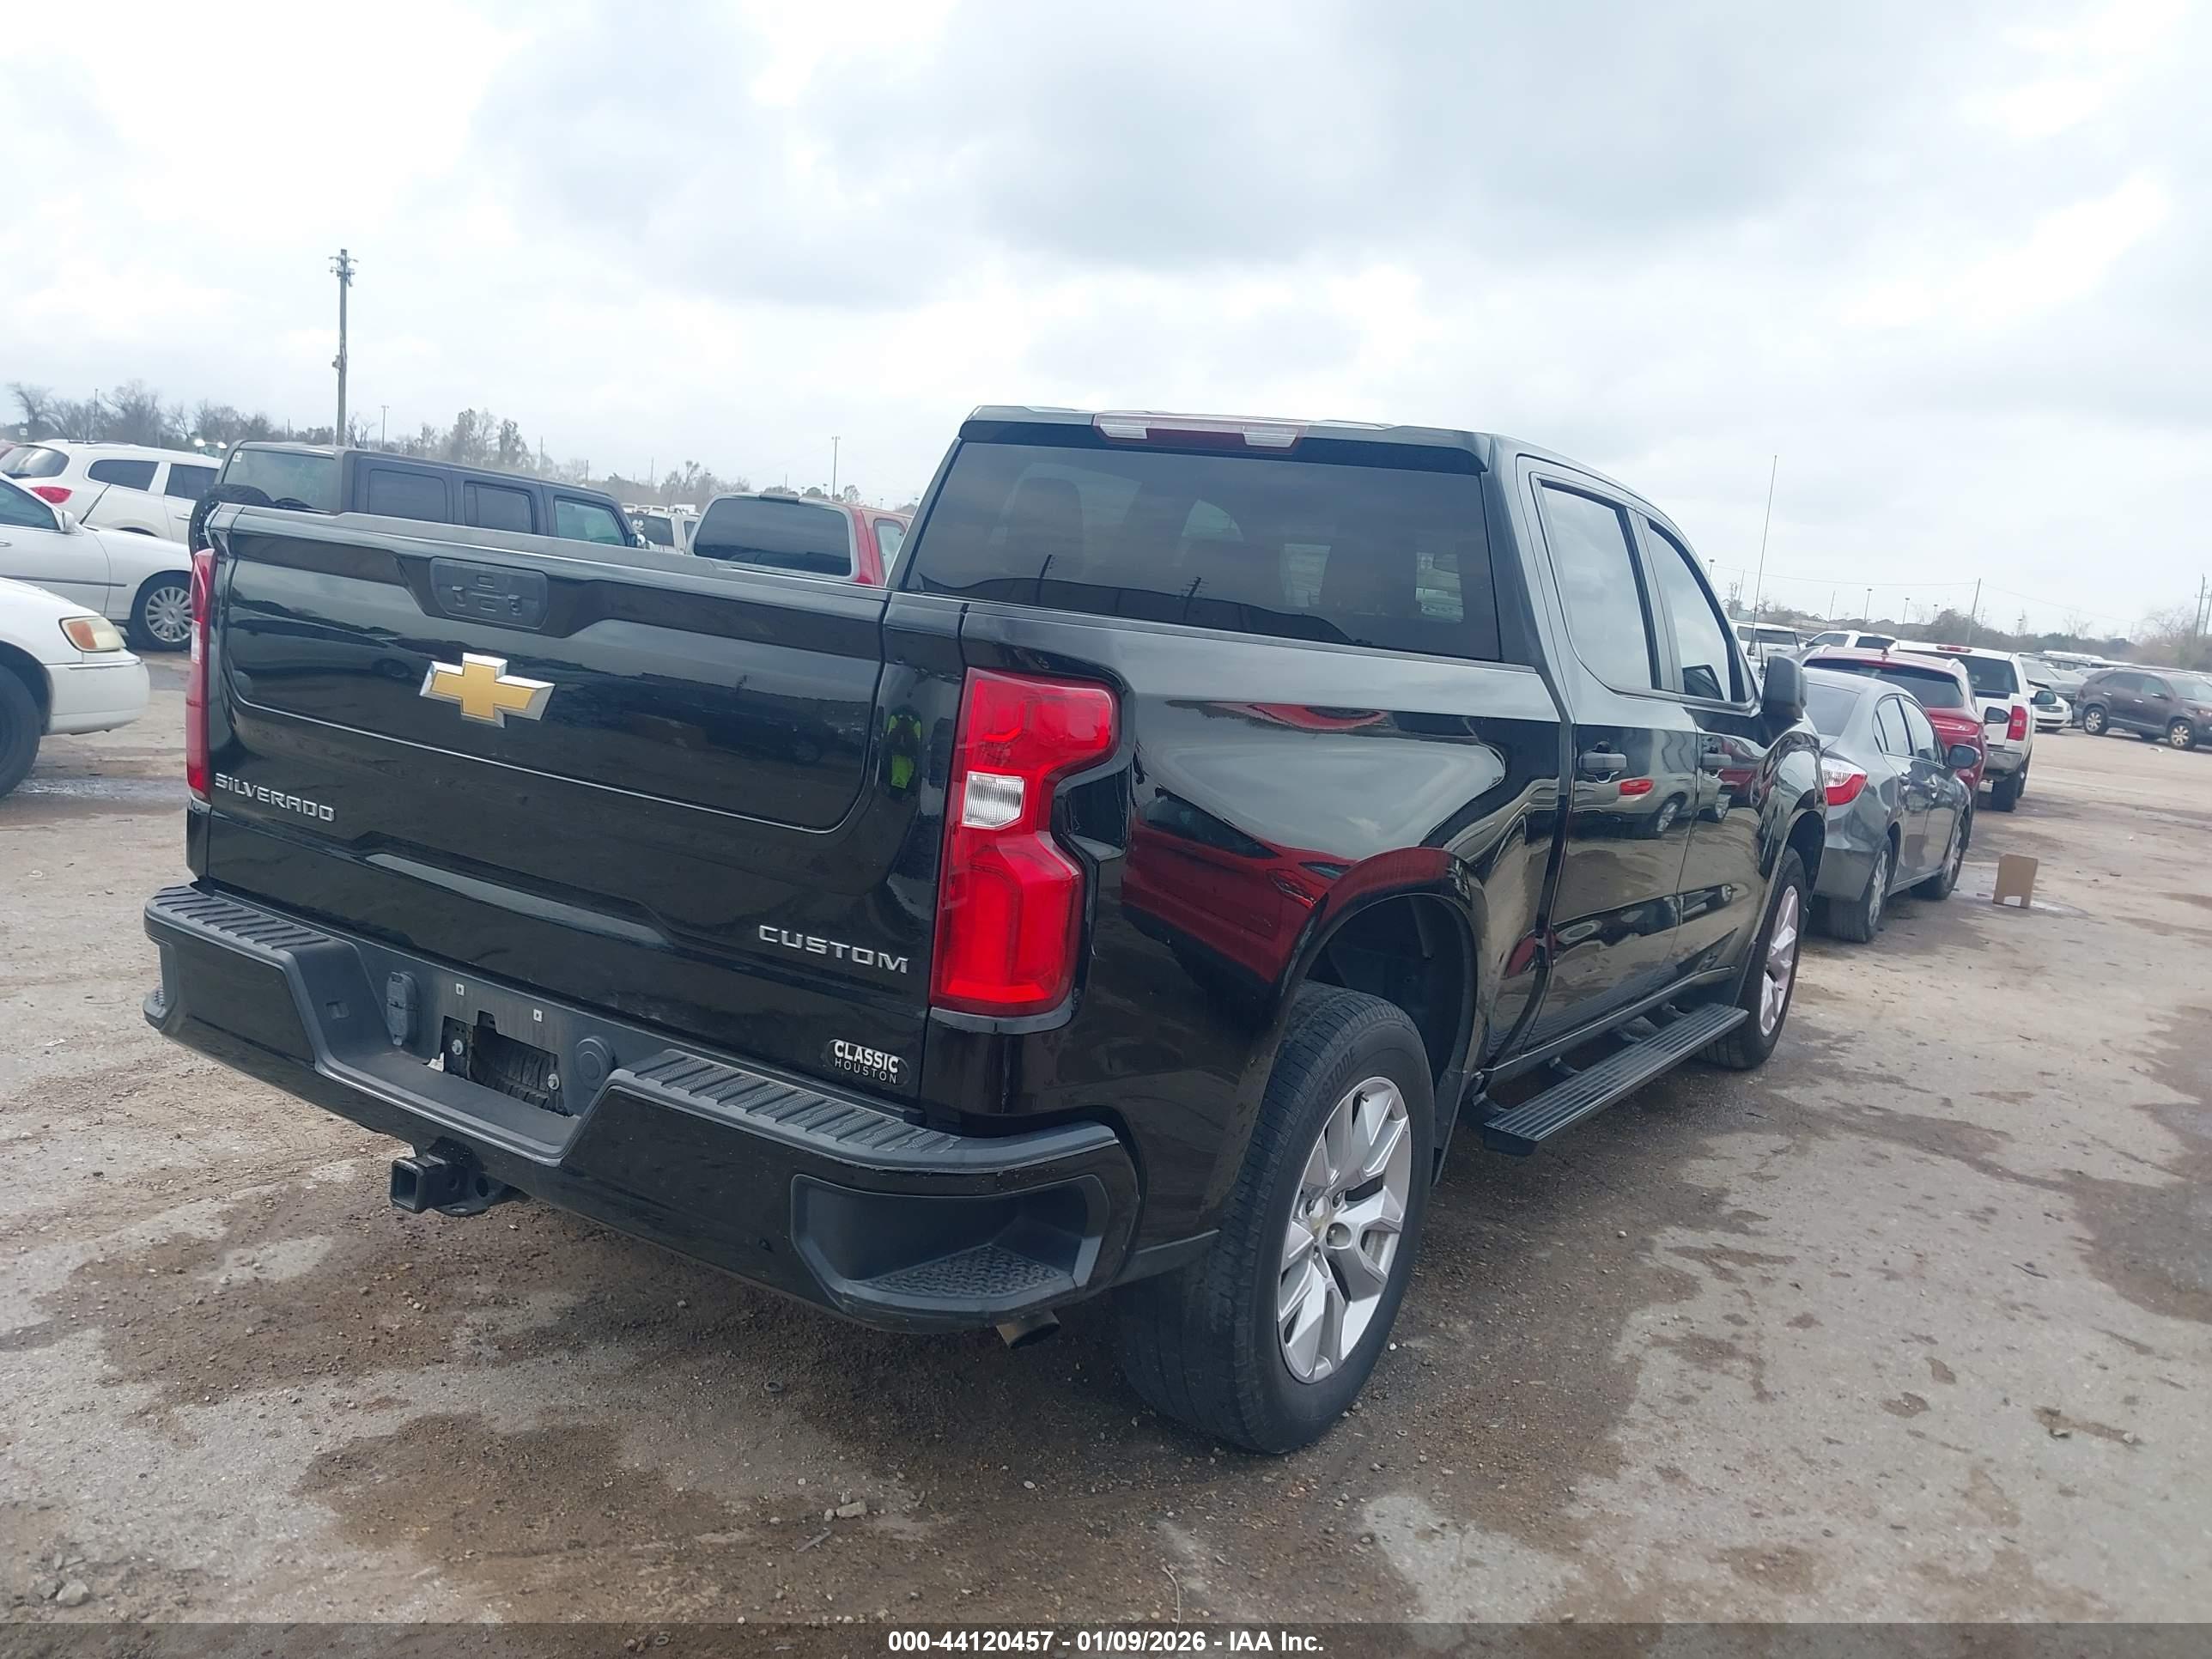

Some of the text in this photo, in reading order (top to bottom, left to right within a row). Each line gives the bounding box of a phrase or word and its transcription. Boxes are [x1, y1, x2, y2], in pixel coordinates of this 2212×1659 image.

[215, 772, 335, 823] SILVERADO
[759, 925, 908, 974] CUSTOM
[833, 1040, 900, 1074] CLASSIC
[834, 1057, 897, 1085] HOUSTON
